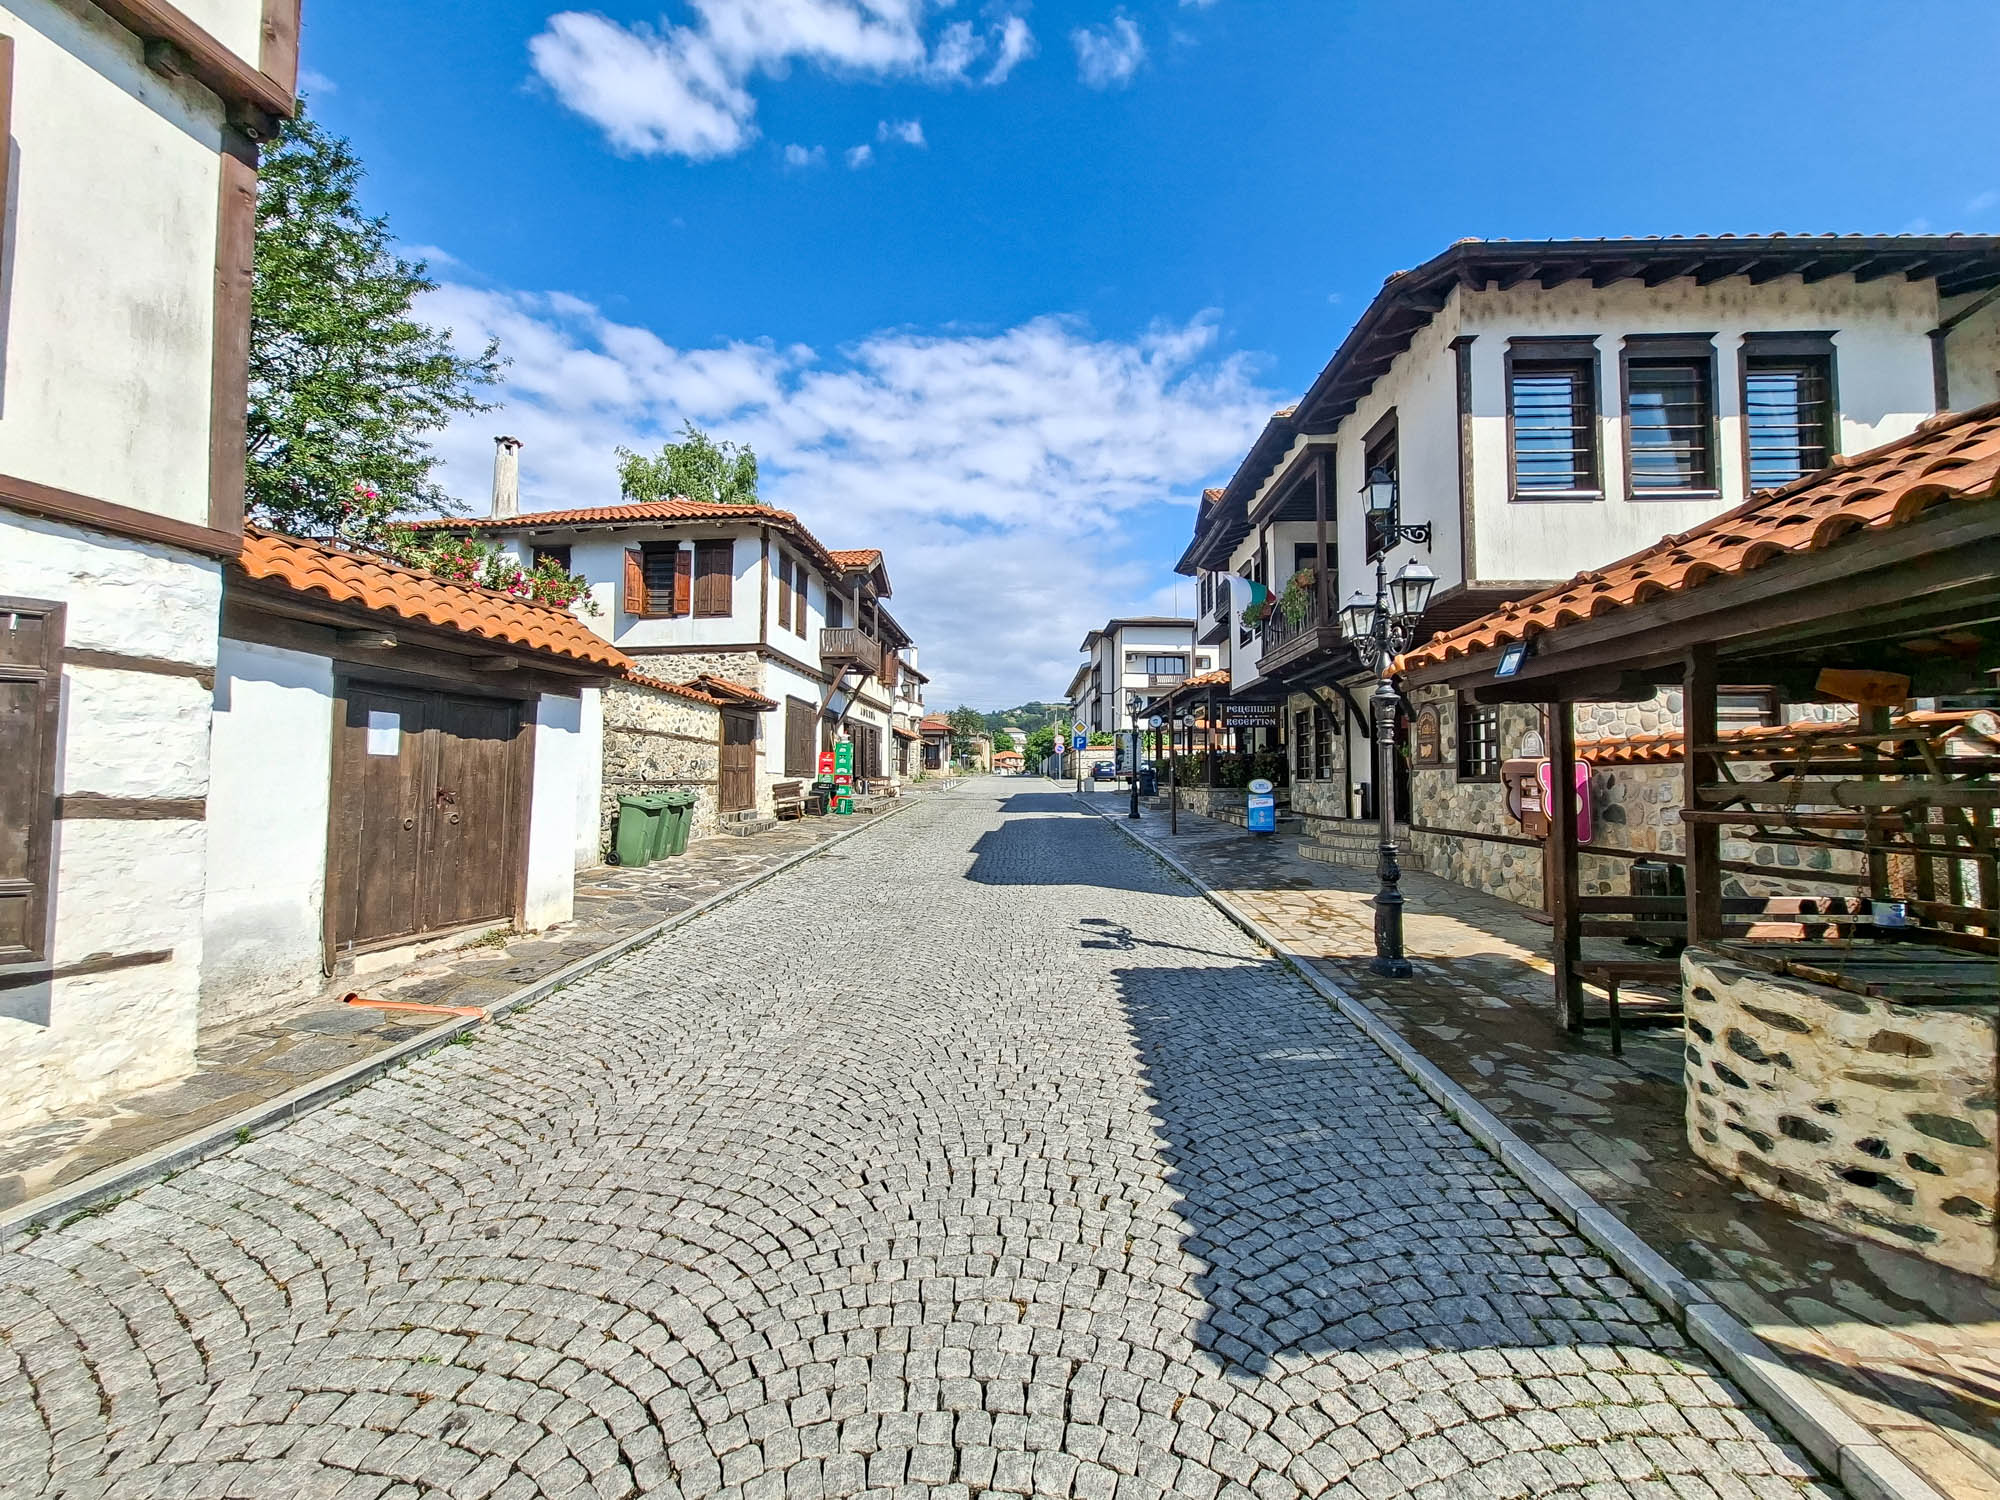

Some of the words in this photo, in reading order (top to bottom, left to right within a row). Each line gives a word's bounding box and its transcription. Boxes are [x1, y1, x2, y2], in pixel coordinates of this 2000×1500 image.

[1226, 705, 1276, 714] РЕЦЕПЦИЯ
[1226, 718, 1276, 726] RECEPTION
[1076, 737, 1084, 748] P
